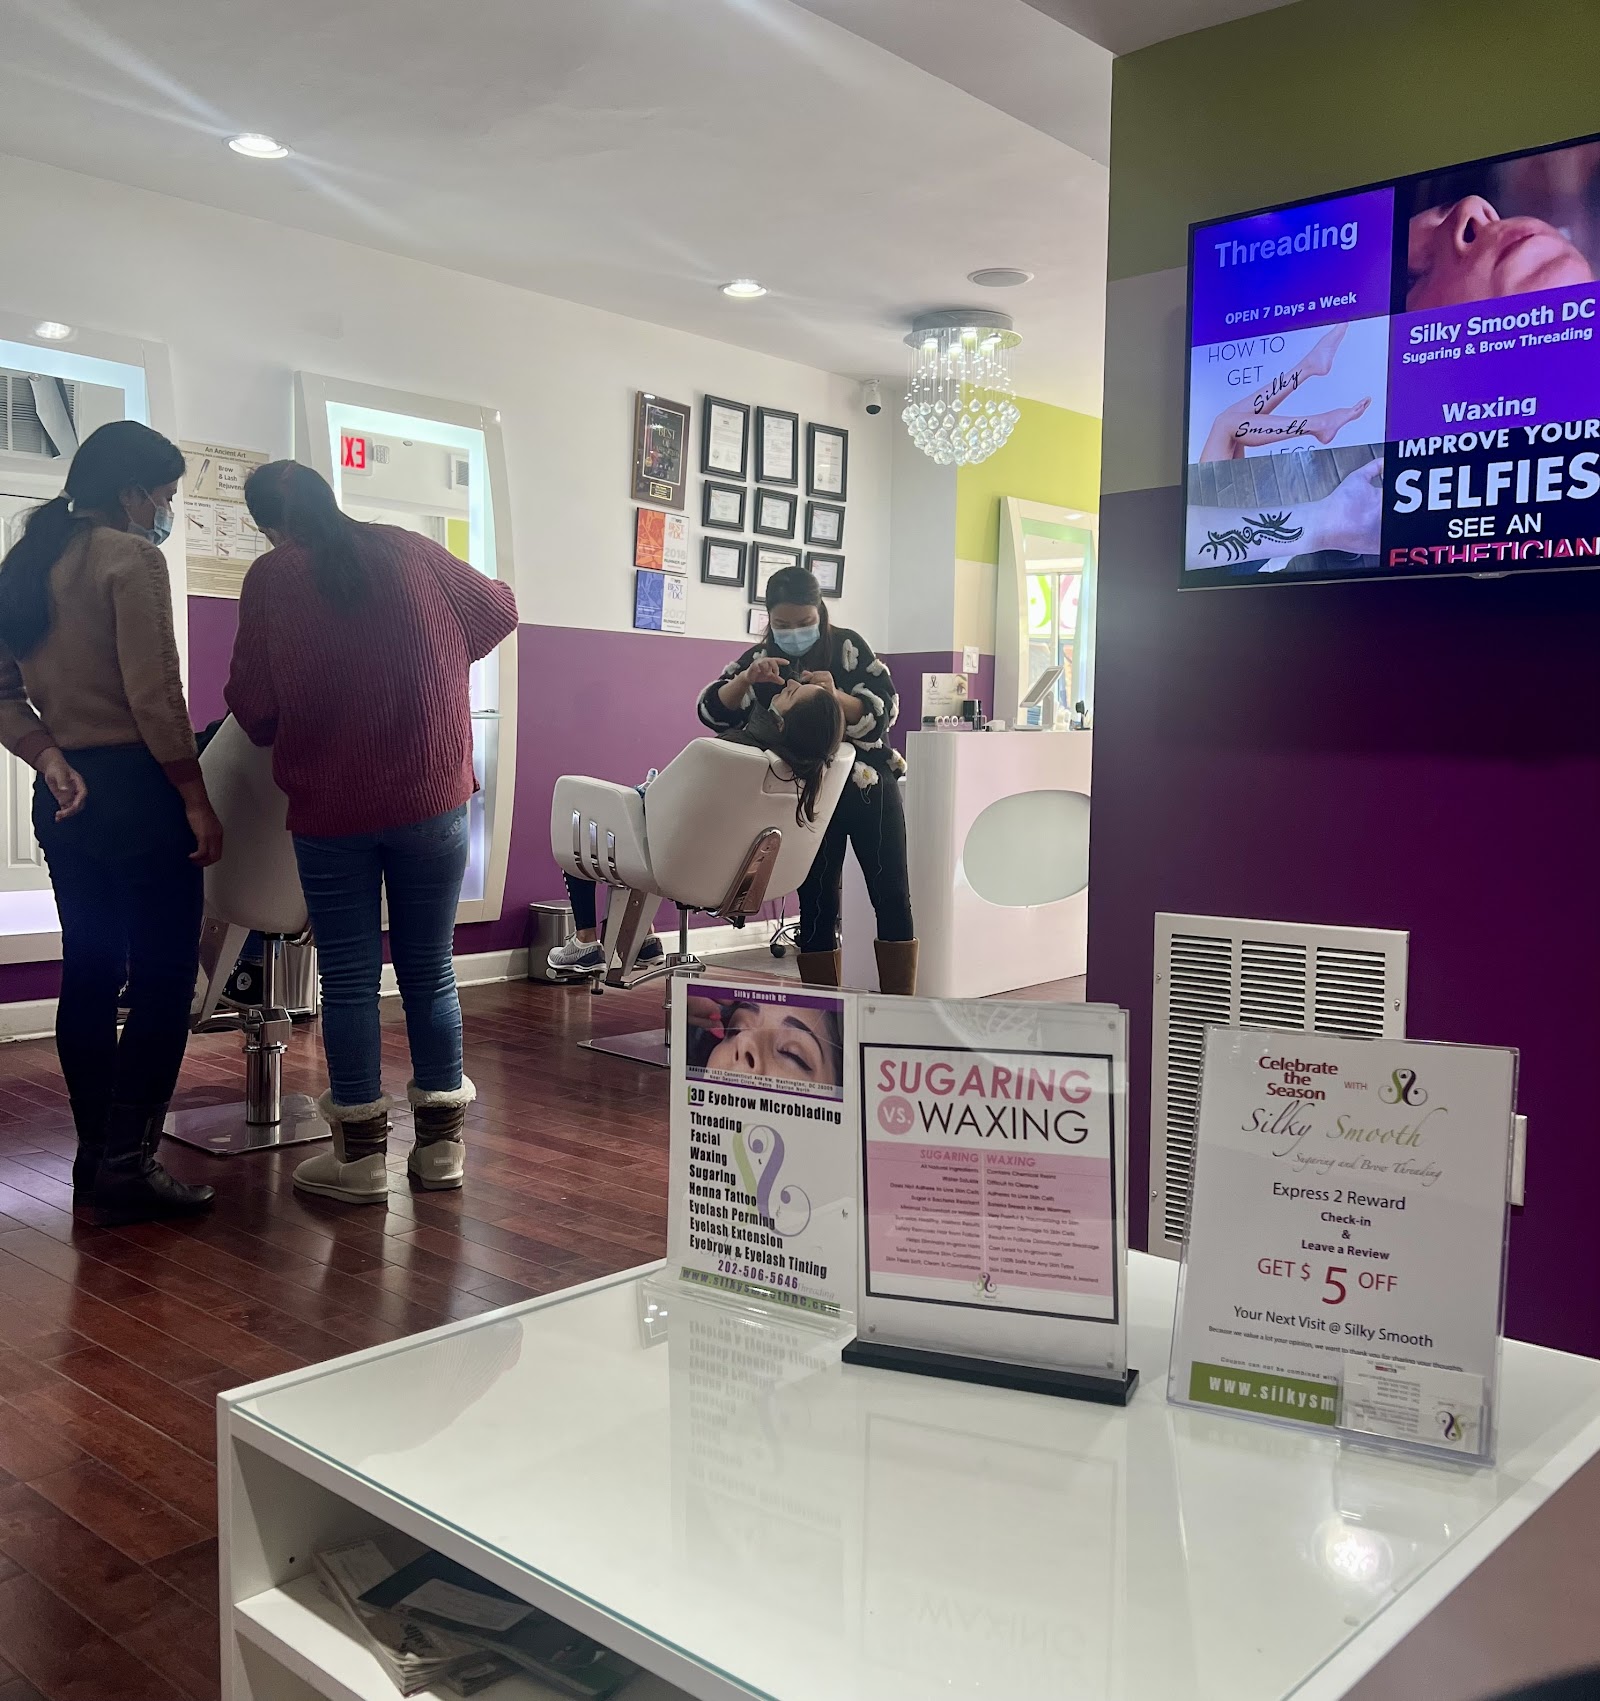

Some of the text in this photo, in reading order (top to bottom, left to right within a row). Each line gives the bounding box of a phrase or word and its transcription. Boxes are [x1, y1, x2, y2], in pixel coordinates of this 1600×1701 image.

[1215, 222, 1358, 268] Threading
[1225, 292, 1356, 324] OPEN 7 Days a Week
[1410, 298, 1596, 344] Silky Smooth DC
[1208, 336, 1285, 363] HOW TO
[1402, 328, 1593, 364] Sugaring & Brow Threading
[1228, 366, 1263, 386] GET
[1254, 369, 1302, 414] Silky
[1442, 396, 1536, 423] Waxing
[1235, 419, 1312, 438] Smooth
[1398, 419, 1600, 458] IMPROVE YOUR
[214, 448, 236, 456] Ancient
[224, 474, 238, 482] Lash
[1393, 452, 1600, 514] SELFIES
[1448, 512, 1542, 538] SEE AN
[664, 548, 686, 560] 2018
[734, 990, 786, 1002] Silky Smooth DC
[724, 1072, 752, 1080] Connecticut
[1259, 1056, 1338, 1075] Celebrate
[877, 1060, 1092, 1104] SUGARING
[1266, 1083, 1326, 1100] Season
[1284, 1072, 1311, 1086] the
[1344, 1082, 1368, 1090] WITH
[691, 1088, 842, 1124] 3D Eyebrow Microblading
[690, 1112, 742, 1133] Threading
[882, 1101, 1088, 1144] VS. WAXING
[1242, 1100, 1448, 1157] Silky Smooth
[691, 1129, 720, 1146] Facial
[690, 1146, 727, 1166] Waxing
[920, 1150, 978, 1162] SUGARING
[986, 1154, 1036, 1167] WAXING
[690, 1164, 736, 1186] Sugaring
[1293, 1153, 1442, 1187] Sugaring and Brow Threading
[690, 1182, 756, 1206] Henna Tattoo
[1273, 1182, 1406, 1210] Express 2 Reward
[690, 1200, 775, 1230] Eyelash Perming
[1321, 1212, 1371, 1226] Check-in
[690, 1217, 782, 1248] Eyelash Extension
[1342, 1230, 1350, 1240] &
[690, 1234, 827, 1279] Eyebrow & Eyelash Tinting
[1302, 1240, 1390, 1260] Leave a Review
[718, 1260, 798, 1289] 202-506-5646
[1258, 1258, 1398, 1304] GET $ 5 OFF
[1234, 1306, 1433, 1348] Your Next Visit @ Silky Smooth
[1208, 1326, 1232, 1335] Because
[1288, 1339, 1314, 1349] opinion,
[1350, 1348, 1367, 1357] thank
[1220, 1356, 1246, 1366] Coupon
[1287, 1368, 1320, 1378] combined
[1209, 1376, 1334, 1412] www.silkysm
